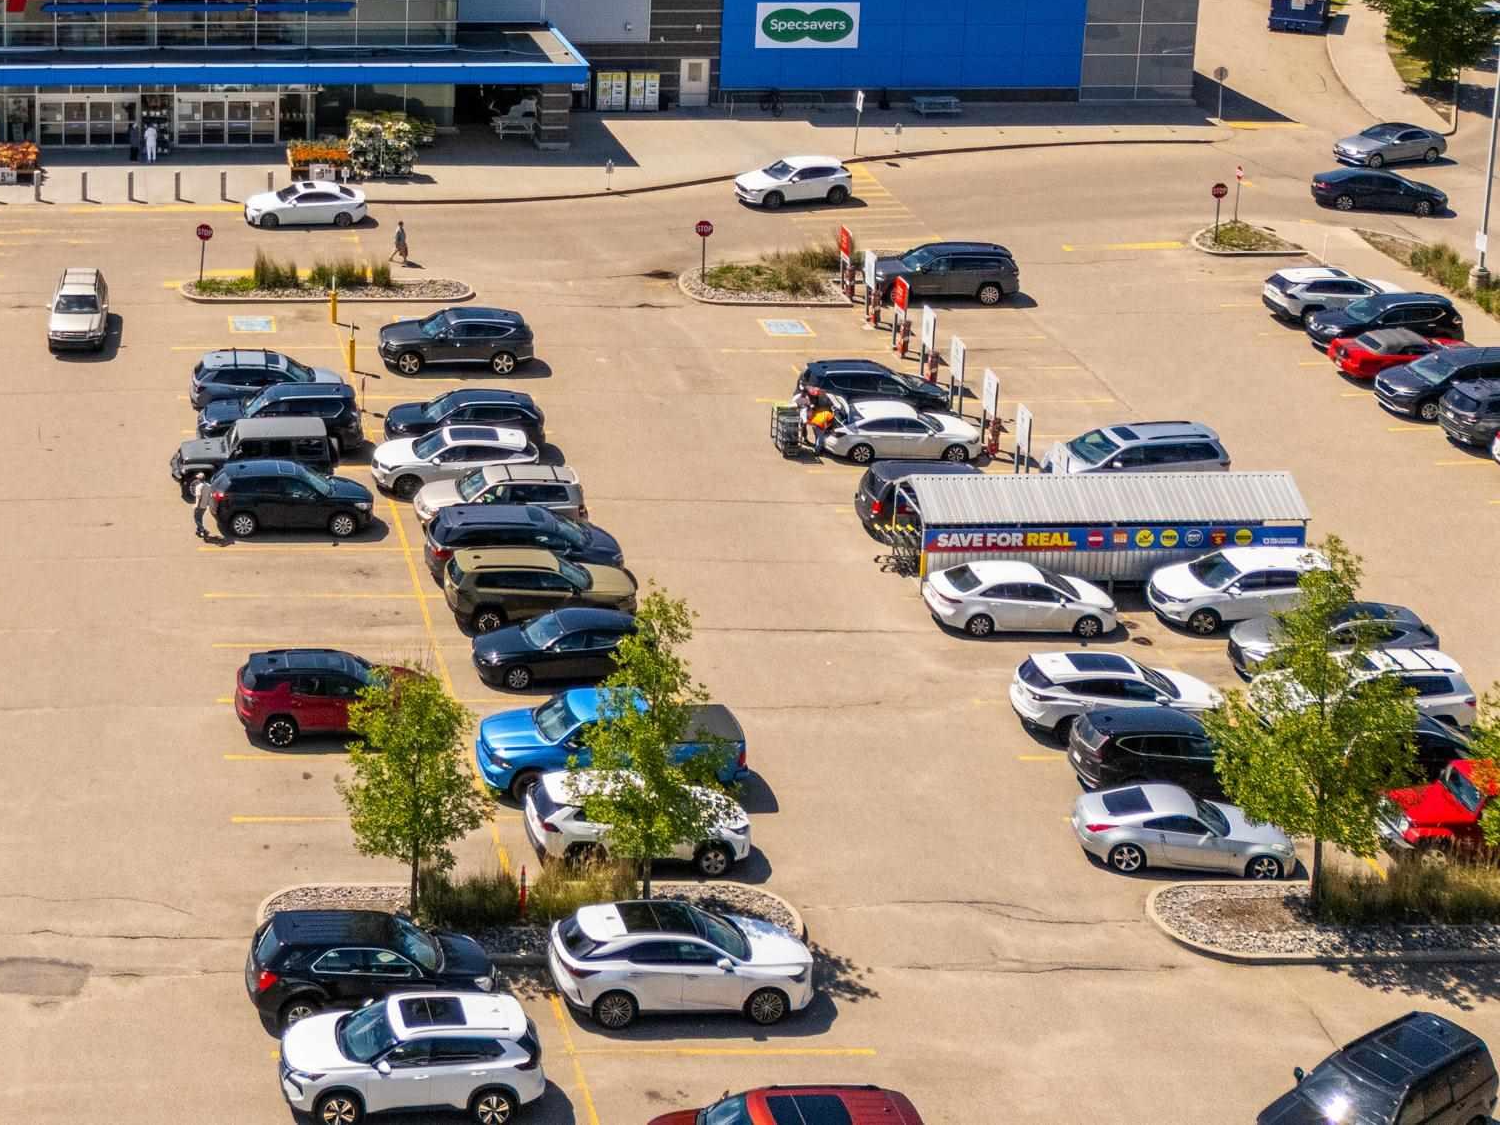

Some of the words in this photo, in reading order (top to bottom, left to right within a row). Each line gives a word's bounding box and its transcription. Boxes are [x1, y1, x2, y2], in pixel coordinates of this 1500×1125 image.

[770, 18, 846, 32] Specsavers
[937, 532, 983, 547] SAVE
[986, 532, 1024, 546] FOR
